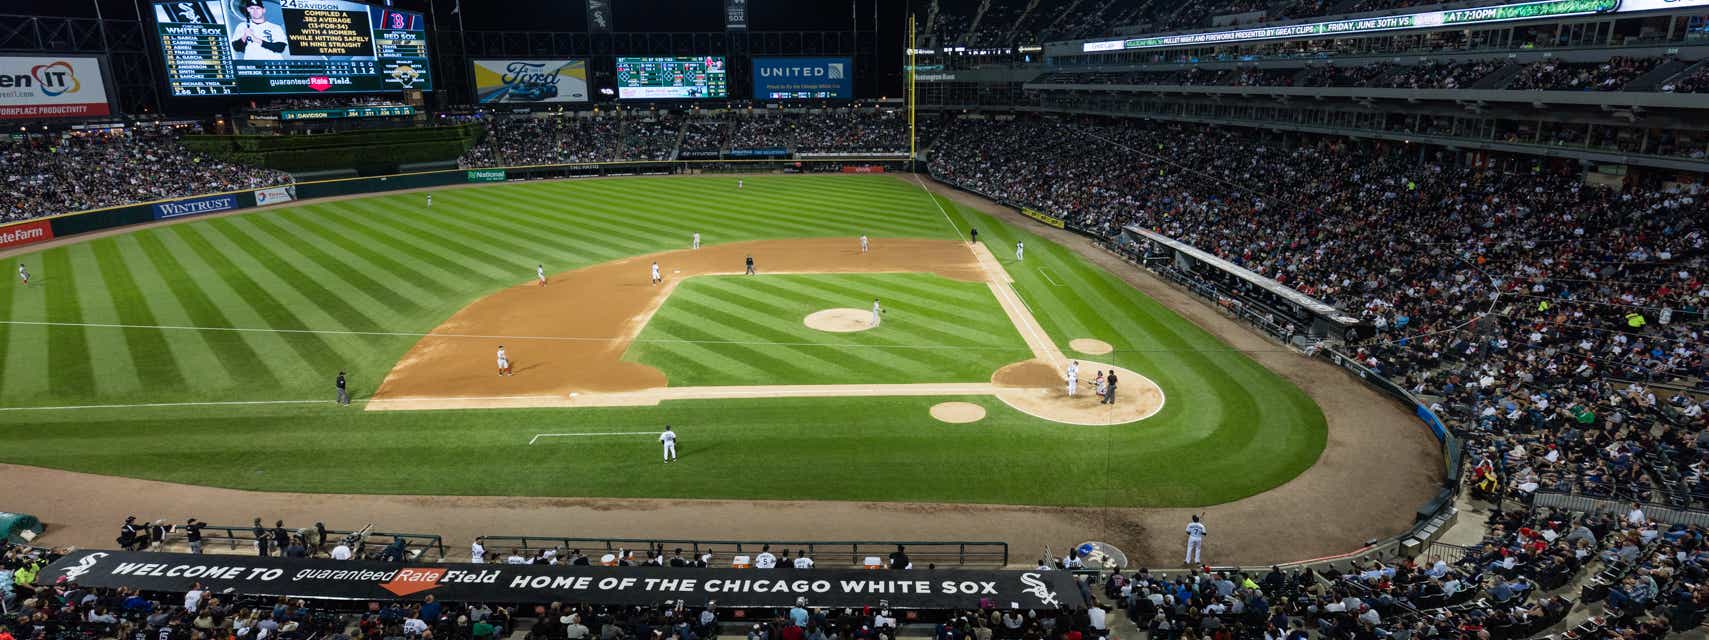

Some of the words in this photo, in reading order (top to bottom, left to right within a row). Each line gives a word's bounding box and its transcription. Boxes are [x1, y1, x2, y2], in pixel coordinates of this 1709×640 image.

[281, 0, 297, 8] 24
[1449, 12, 1464, 21] AT
[1464, 9, 1497, 20] 7:10PM
[166, 27, 199, 35] WHITE
[1327, 21, 1355, 32] FRIDAY,
[1356, 20, 1376, 29] JUNE
[1376, 19, 1397, 28] 30TH
[1398, 18, 1410, 26] VS
[1206, 33, 1235, 41] FIREWORKS
[1235, 30, 1265, 39] PRESENTED
[1266, 29, 1274, 37] BY
[1275, 28, 1296, 36] GREAT
[1296, 26, 1314, 34] CLIPS
[502, 62, 561, 85] Ford
[760, 67, 824, 77] UNITED
[44, 71, 66, 88] IT
[270, 78, 310, 87] guaranteed
[39, 105, 88, 114] PRODUCTIVITY
[111, 562, 247, 580] WELCOME
[244, 566, 284, 582] TO
[293, 568, 399, 586] guaranteed
[396, 568, 441, 583] Rate
[441, 569, 502, 584] Field
[509, 575, 593, 590] HOME
[597, 577, 637, 591] OF
[644, 578, 697, 593] THE
[703, 579, 831, 594] CHICAGO
[839, 580, 931, 595] WHITE
[941, 581, 999, 595] SOX
